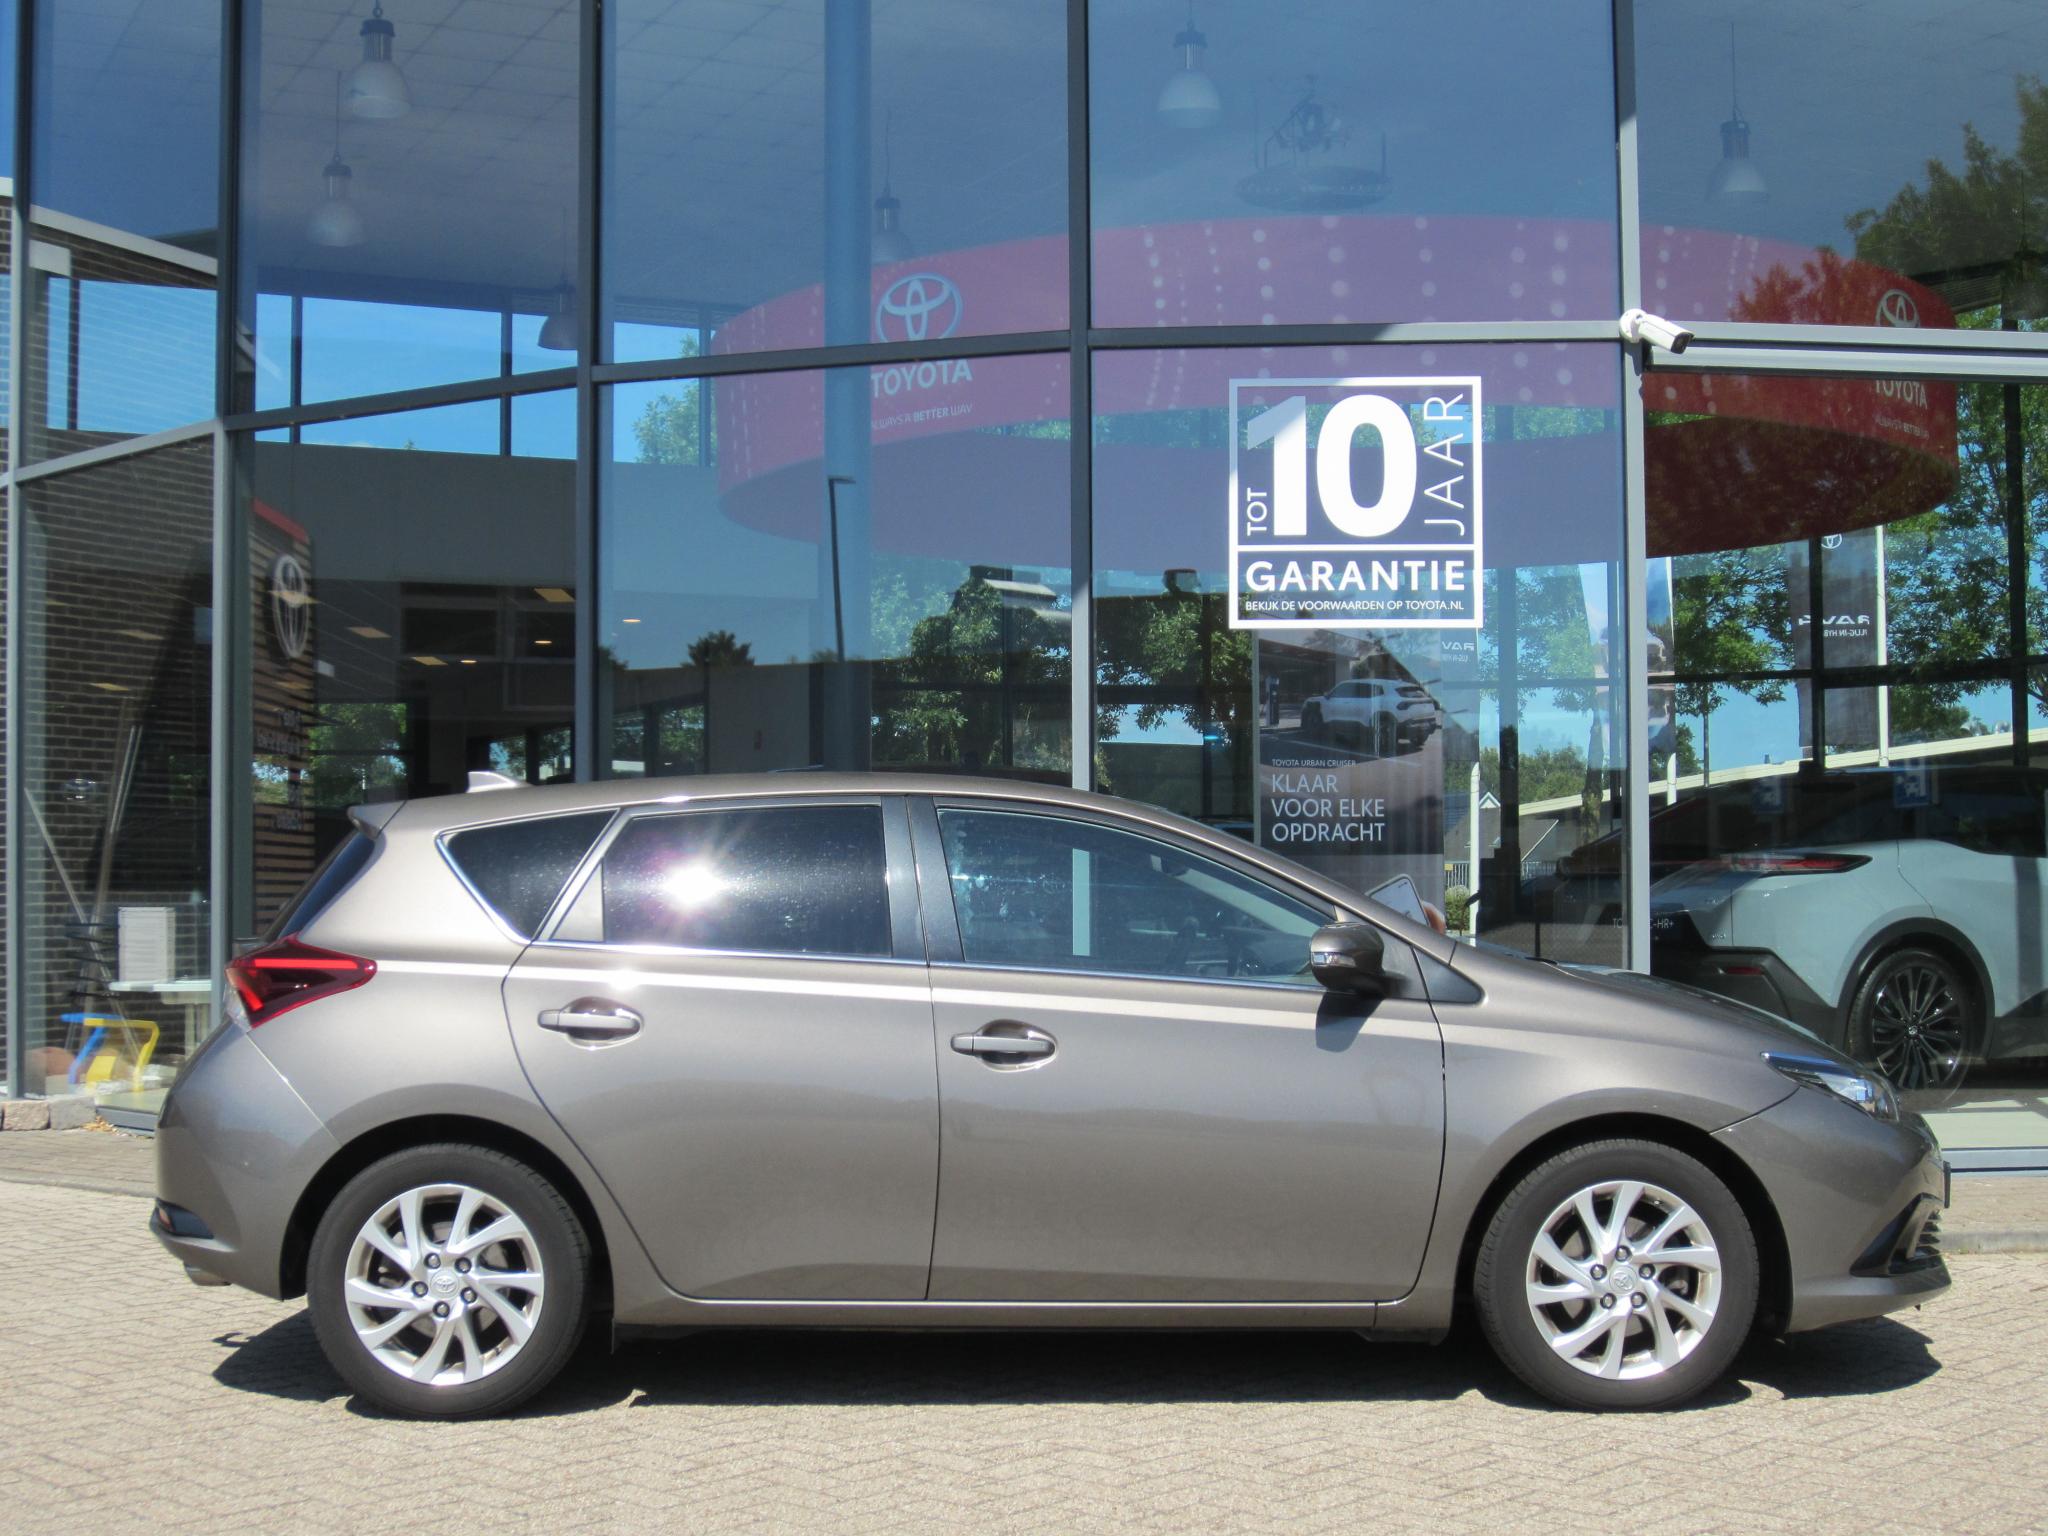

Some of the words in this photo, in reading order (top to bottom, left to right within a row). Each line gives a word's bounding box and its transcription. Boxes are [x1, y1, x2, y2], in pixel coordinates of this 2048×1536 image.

[870, 359, 973, 398] TOYOTA
[1875, 379, 1928, 410] TOYOTA
[913, 406, 949, 422] BETTER
[1247, 394, 1417, 537] 10
[1423, 393, 1465, 536] JAAR
[1246, 487, 1268, 536] TOT
[1245, 560, 1465, 591] GARANTIE
[1245, 601, 1279, 611] BEKIJK
[1281, 601, 1296, 611] DE
[1298, 600, 1385, 611] VOORWAARDEN
[1387, 600, 1403, 611] OP
[1405, 600, 1464, 610] TOYOTA.NL
[1271, 758, 1300, 768] TOYOTA
[1301, 759, 1326, 768] URBAN
[1326, 759, 1357, 768] CRUISER
[1271, 774, 1339, 793] KLAAR
[1271, 798, 1333, 818] VOOR
[1339, 798, 1385, 818] ELKE
[1271, 822, 1386, 842] OPDRACHT
